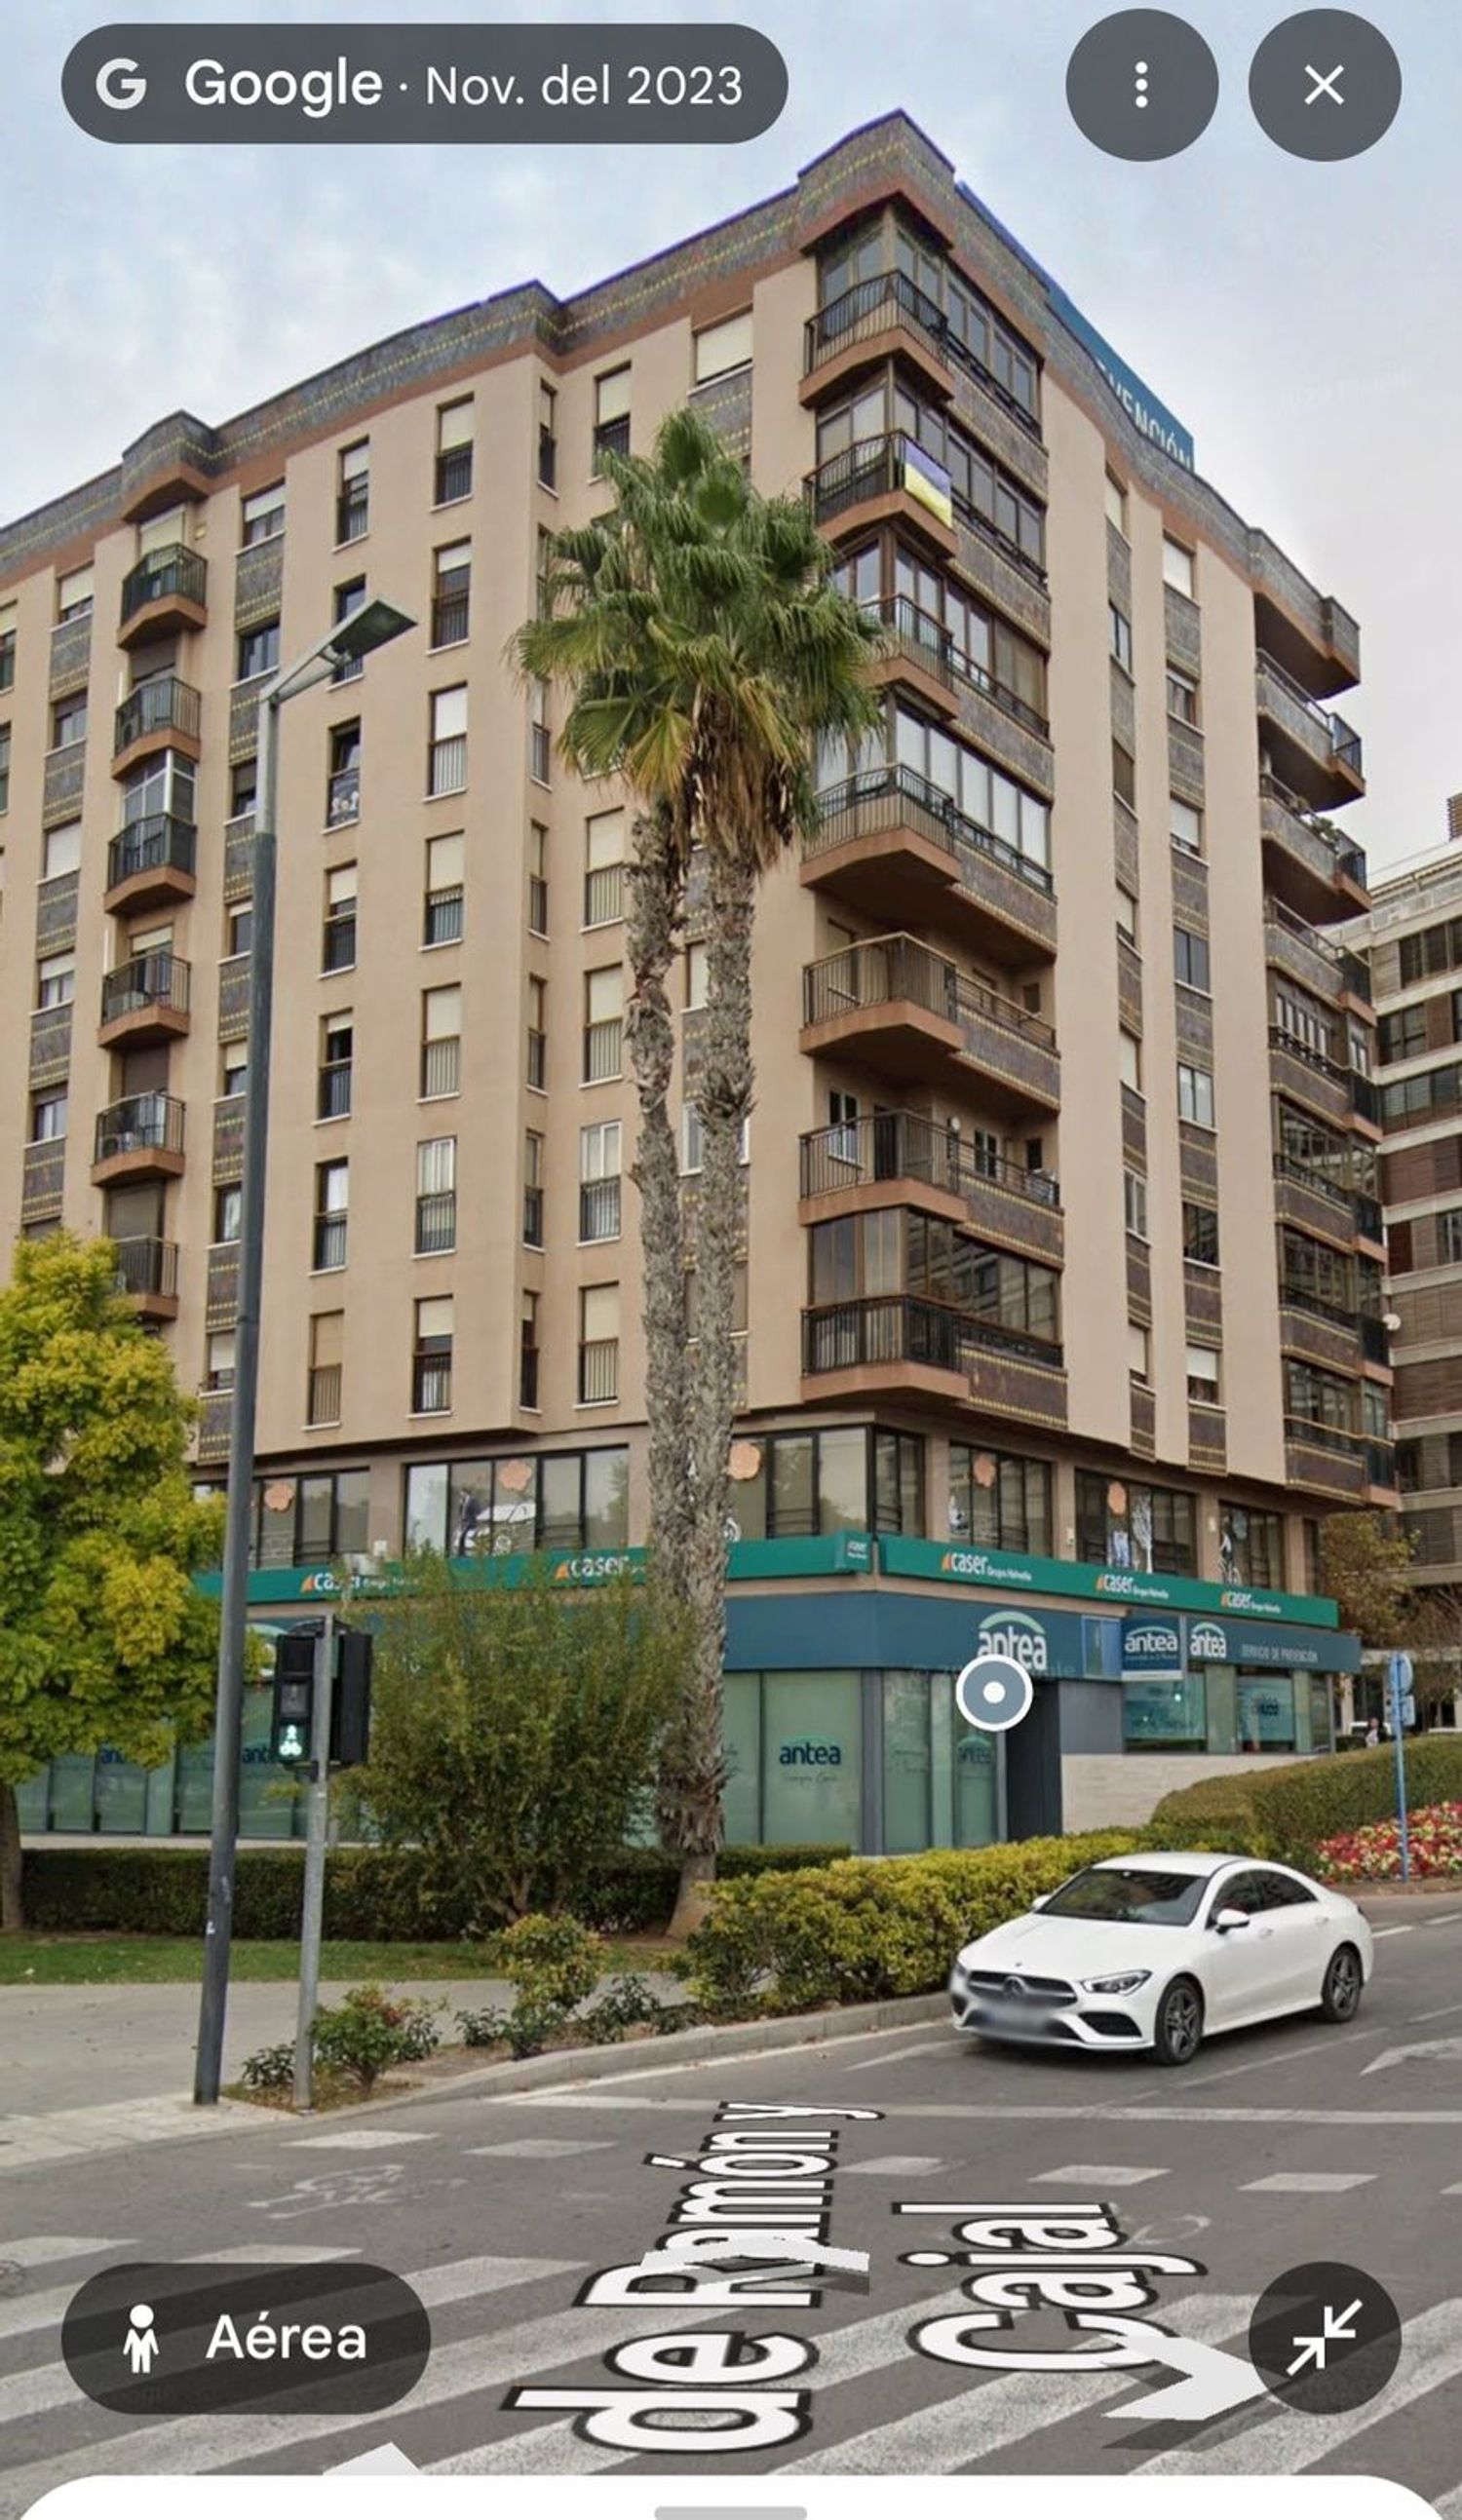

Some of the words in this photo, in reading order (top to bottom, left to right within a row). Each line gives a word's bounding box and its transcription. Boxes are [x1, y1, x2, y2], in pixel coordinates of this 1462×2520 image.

[1097, 360, 1192, 471] VENCIÓN
[569, 1556, 630, 1578] caser
[951, 1552, 988, 1576] caser
[1103, 1574, 1134, 1593] caser
[1227, 1591, 1252, 1609] caser
[977, 1625, 1048, 1670] antea
[1124, 1632, 1178, 1654] antea
[1189, 1630, 1227, 1660] antea
[779, 1742, 842, 1766] antea
